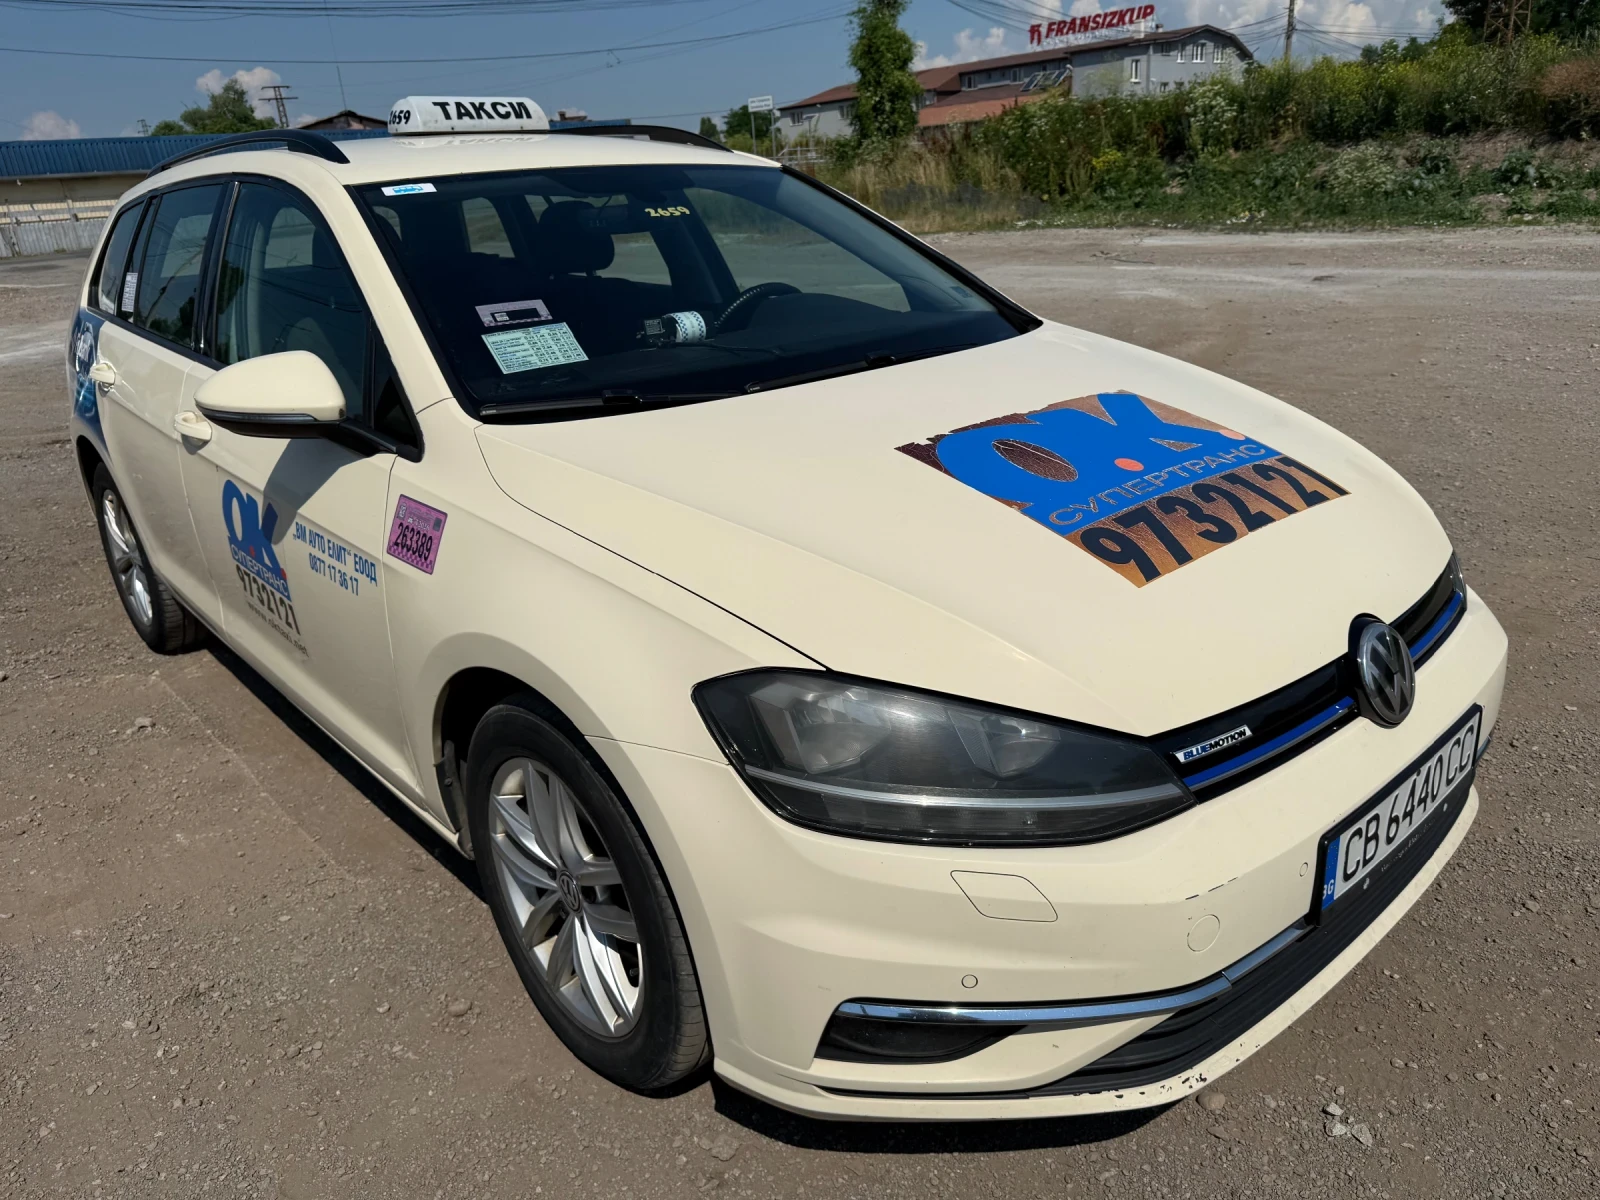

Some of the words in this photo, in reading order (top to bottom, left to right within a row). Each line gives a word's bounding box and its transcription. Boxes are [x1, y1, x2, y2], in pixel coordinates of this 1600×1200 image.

[1045, 4, 1155, 38] FRANSIZKUP
[431, 101, 533, 121] ТАКСИ
[644, 206, 690, 217] 2659
[1048, 443, 1267, 526] СУПЕРТРАНС
[1079, 456, 1352, 583] 9732121
[393, 522, 433, 562] 263389
[230, 543, 289, 597] СУПЕРТРАНС
[308, 552, 326, 577] 0877
[327, 563, 337, 583] 17
[337, 569, 349, 591] 36
[349, 575, 359, 597] 17
[353, 552, 378, 587] ЕООД
[235, 563, 302, 637] 9732121
[1182, 728, 1247, 761] BLUEMOTION
[1385, 753, 1444, 846] 6440
